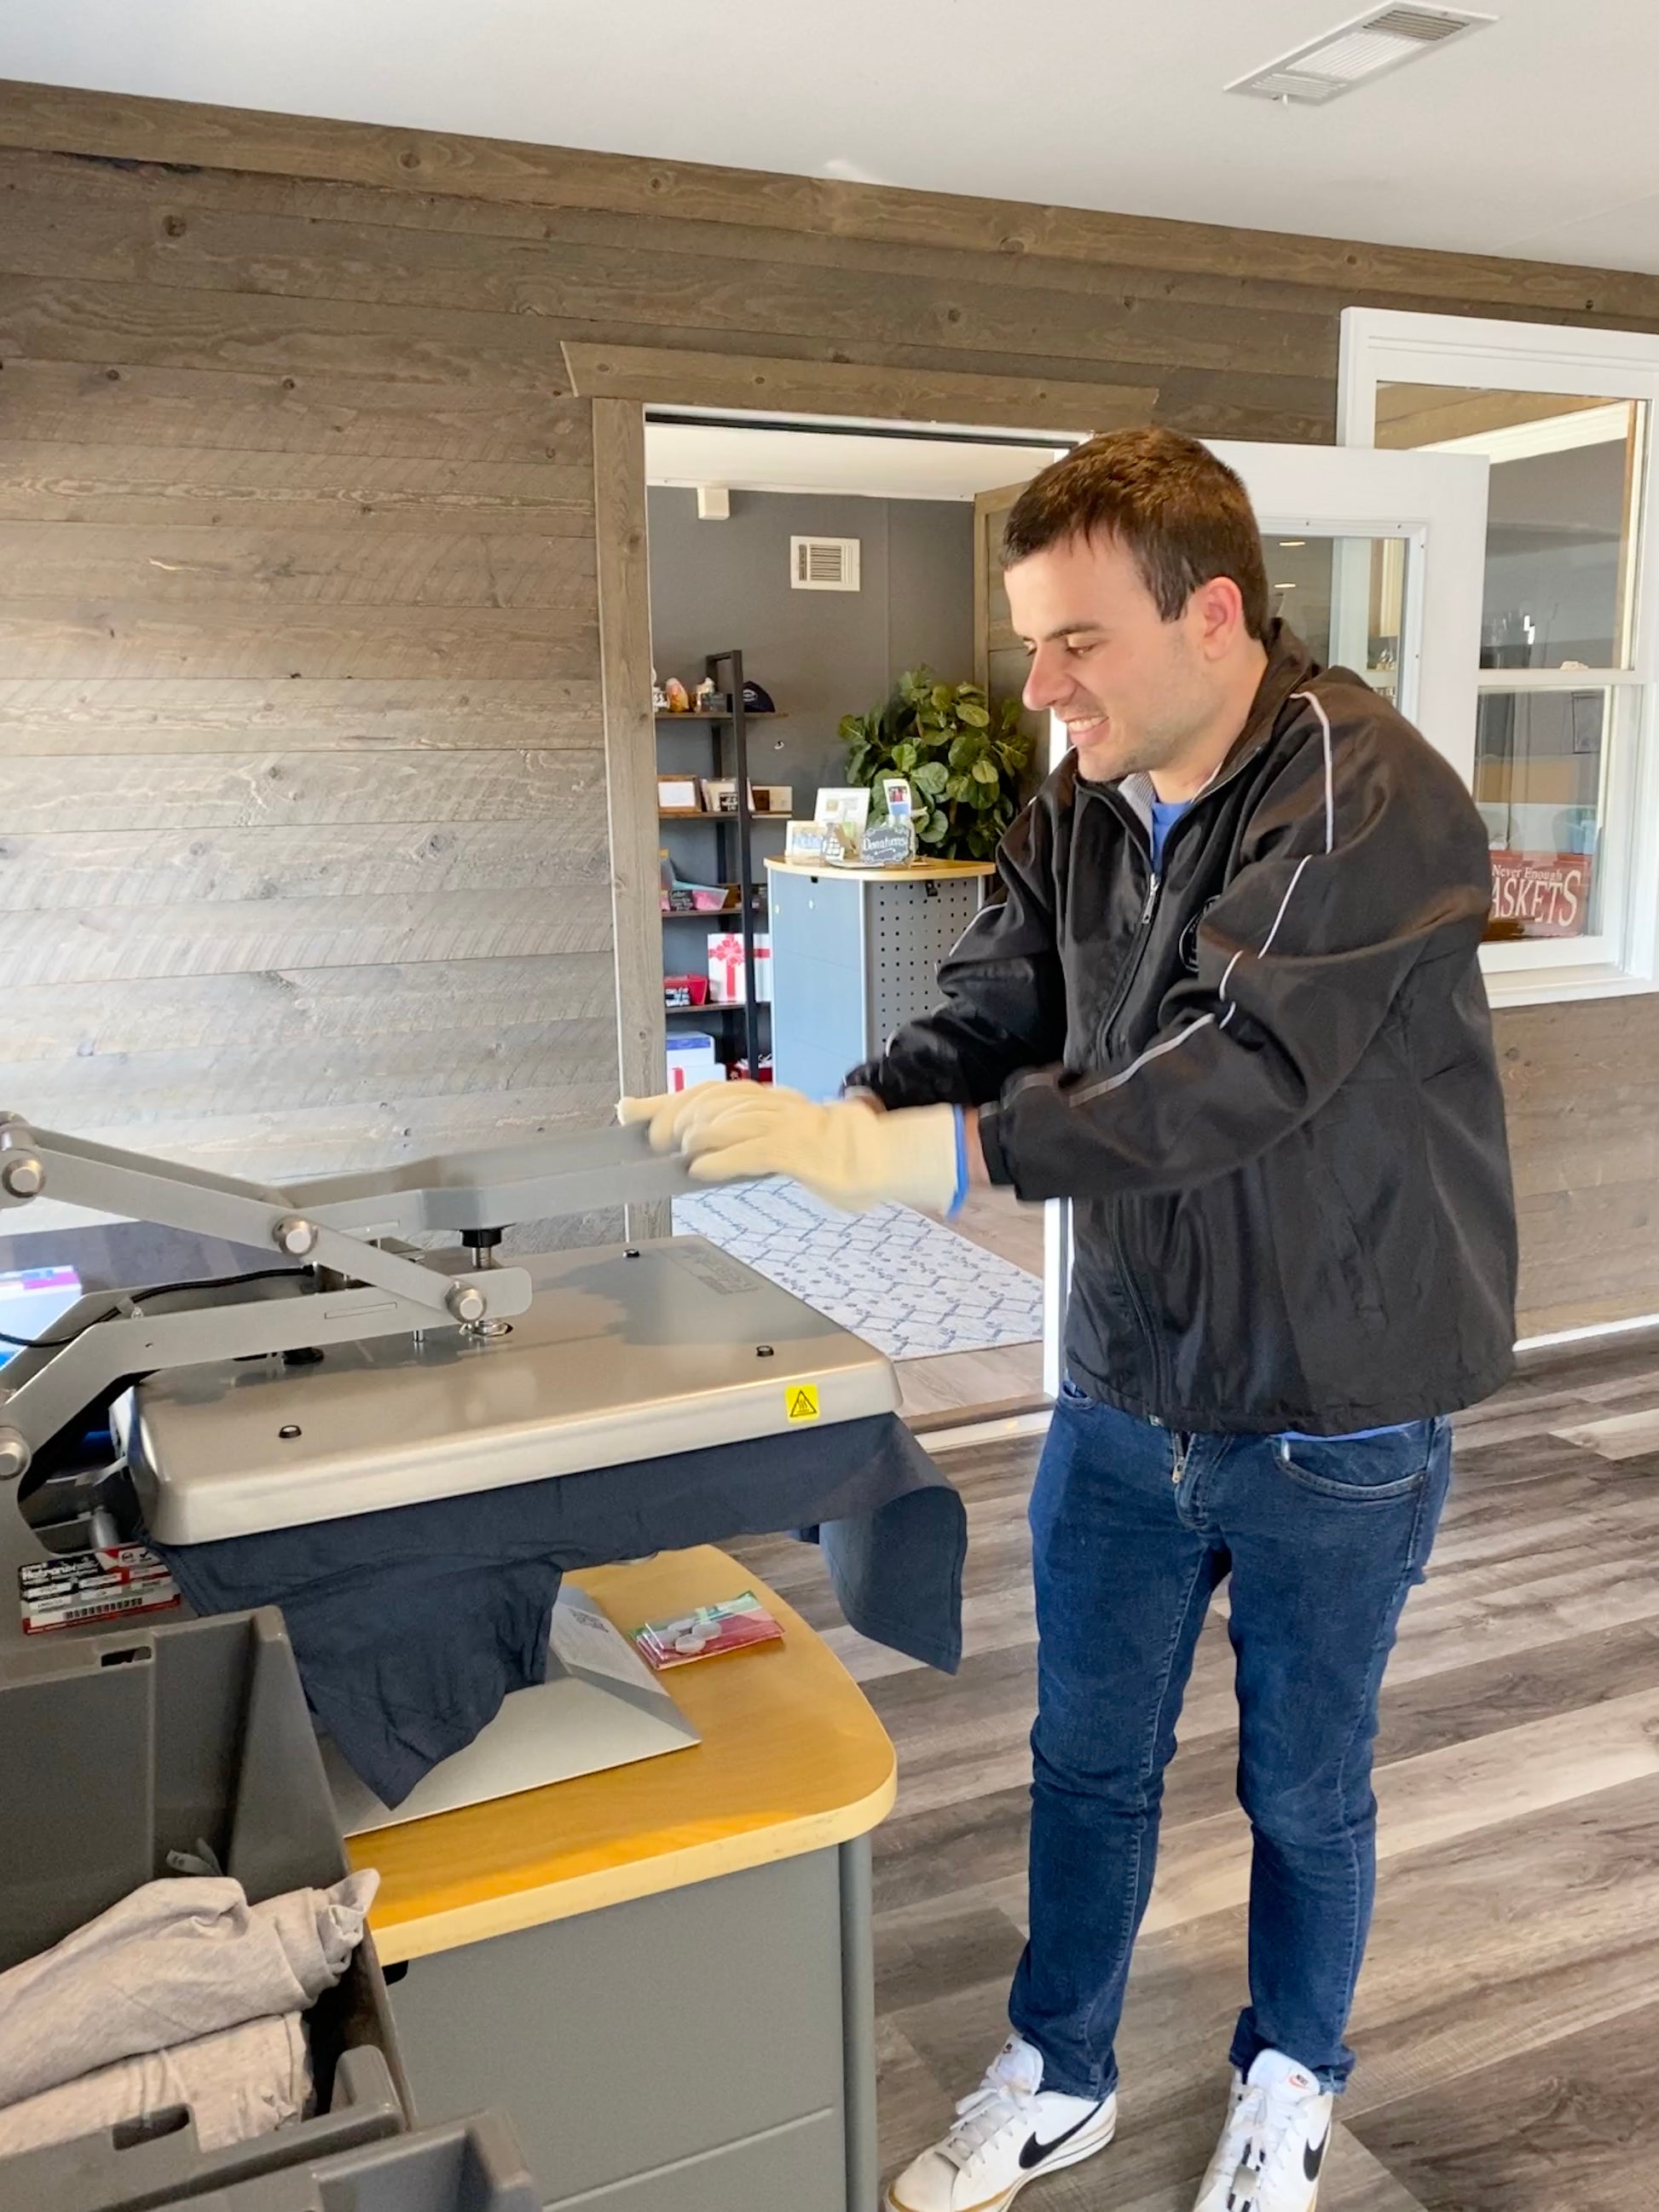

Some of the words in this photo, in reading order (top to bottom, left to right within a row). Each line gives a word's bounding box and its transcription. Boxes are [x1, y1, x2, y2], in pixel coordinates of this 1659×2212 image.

[863, 836, 906, 851] Donations
[1492, 864, 1521, 879] Never
[1524, 867, 1563, 881] Enough
[1491, 869, 1581, 927] ASKETS
